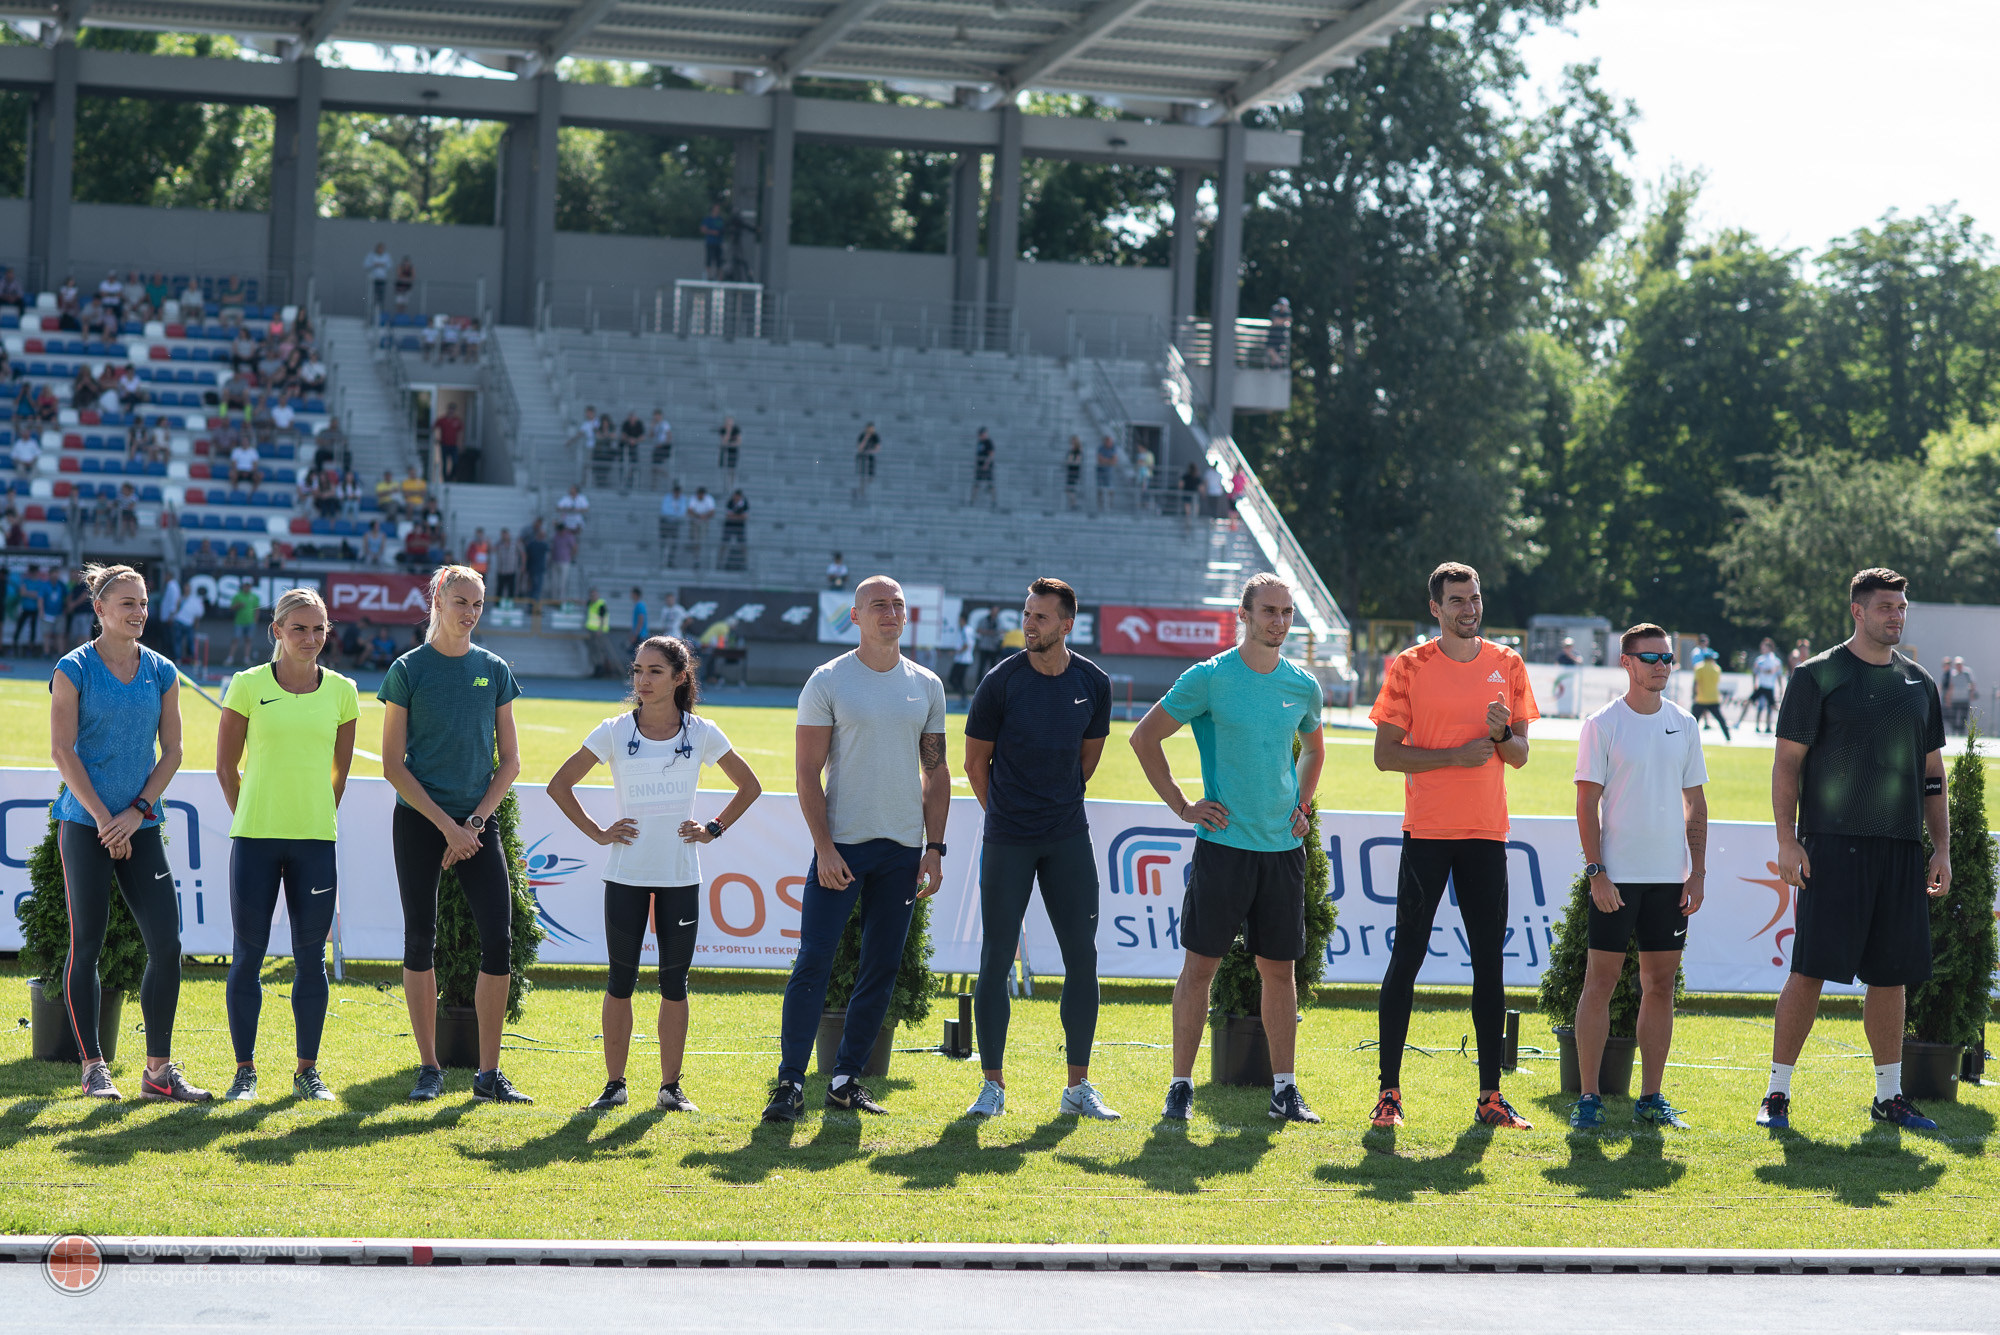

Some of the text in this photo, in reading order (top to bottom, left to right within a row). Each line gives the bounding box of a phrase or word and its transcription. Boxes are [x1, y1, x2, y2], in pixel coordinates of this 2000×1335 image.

[332, 584, 427, 611] PZLA
[628, 781, 688, 798] ENNAOUI
[1114, 905, 1180, 950] sił
[712, 945, 756, 955] SPORTU
[758, 946, 762, 955] I
[765, 946, 799, 955] REKRE
